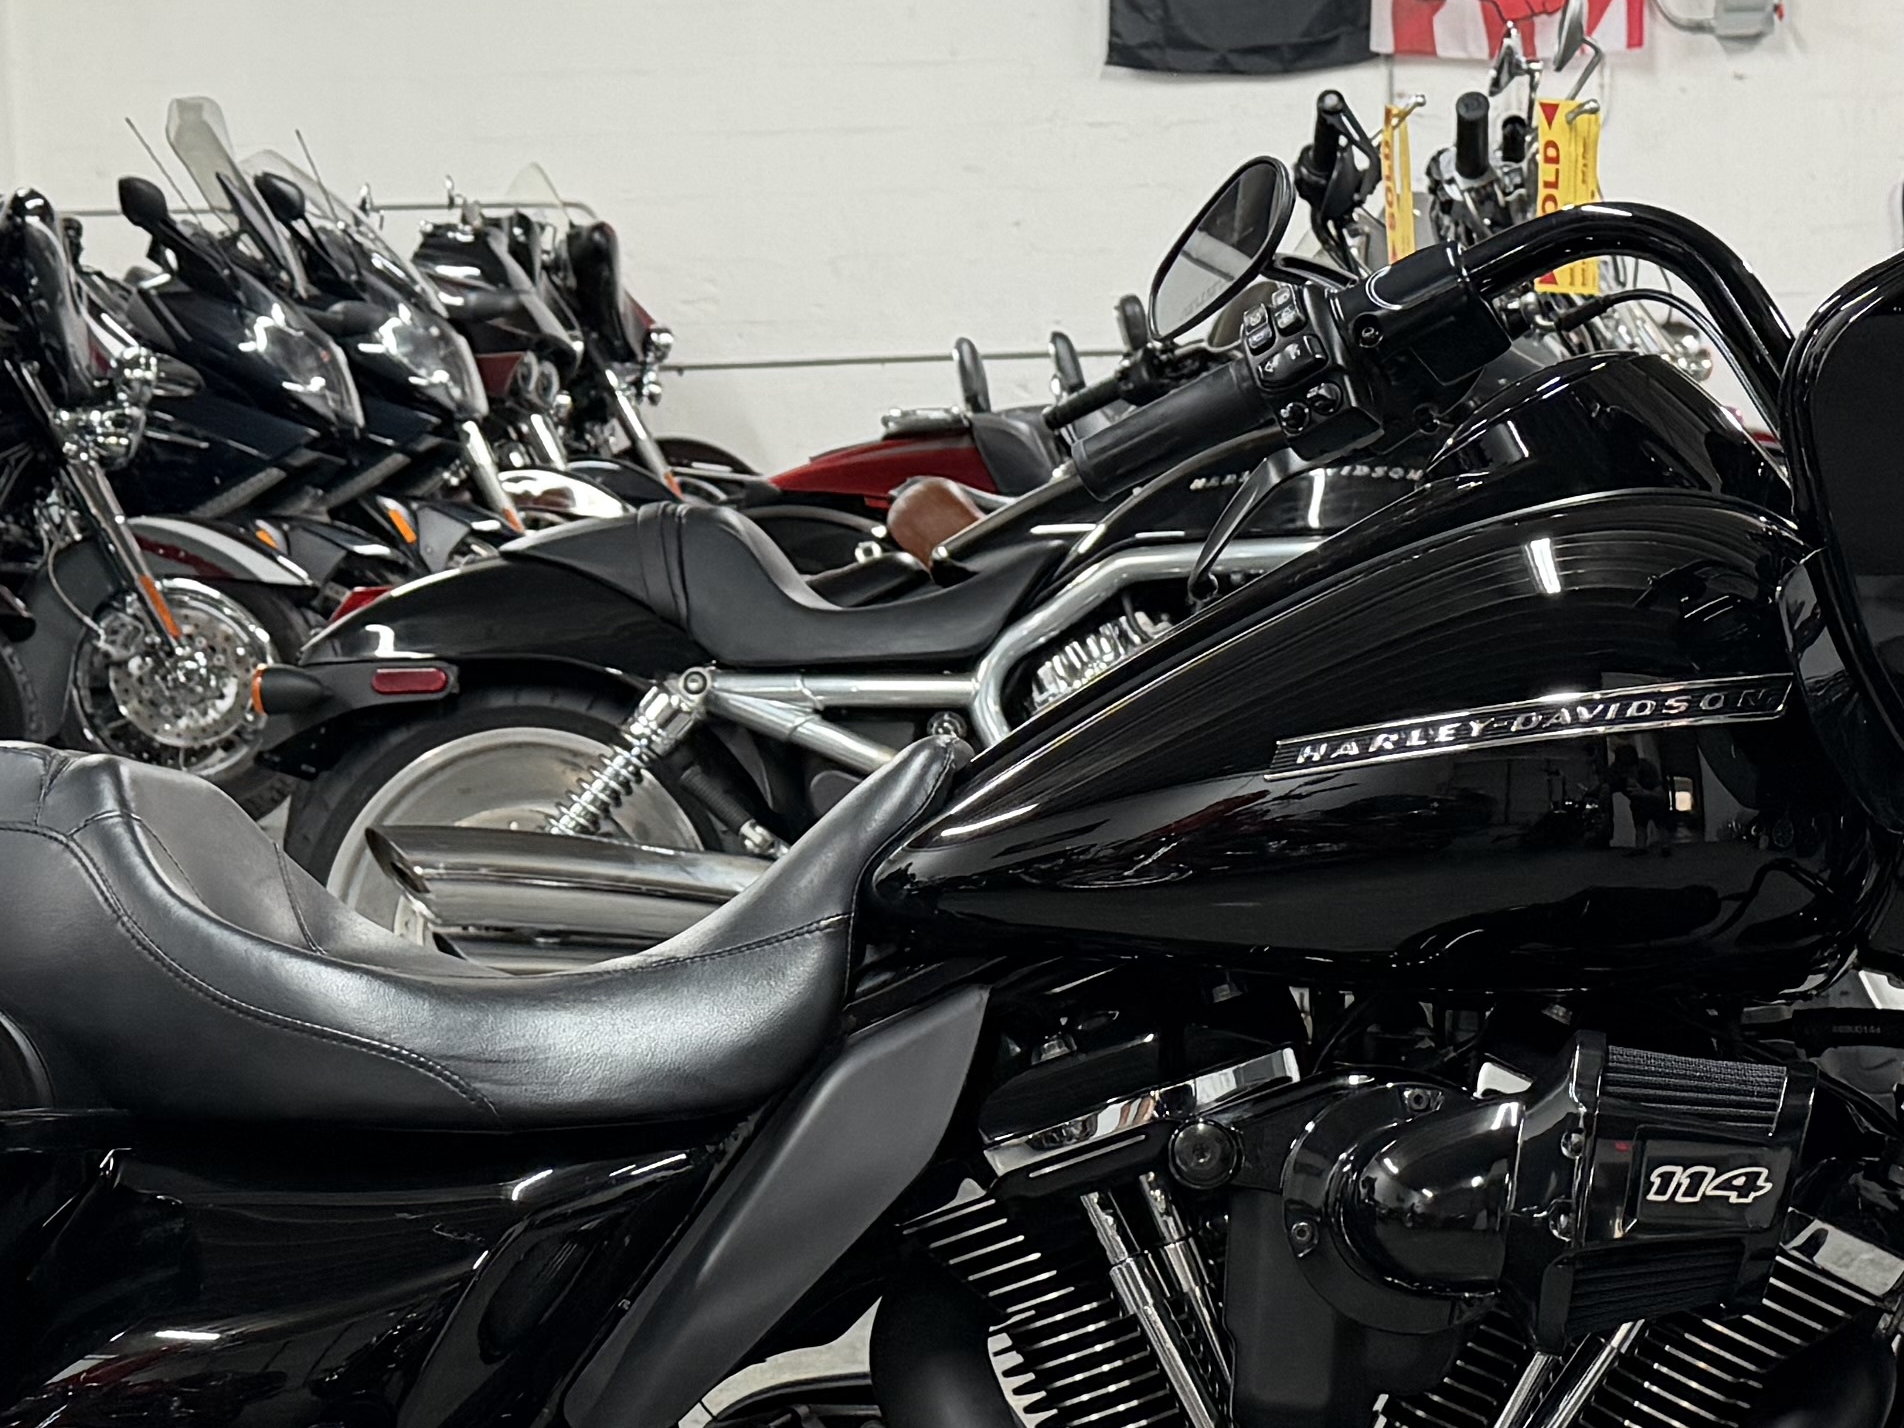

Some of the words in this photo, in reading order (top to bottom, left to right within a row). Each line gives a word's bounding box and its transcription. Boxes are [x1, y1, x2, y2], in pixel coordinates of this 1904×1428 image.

[1541, 139, 1560, 216] OLD
[1296, 689, 1776, 765] HARLEY-DAVIDSON
[1646, 1165, 1773, 1204] 114
